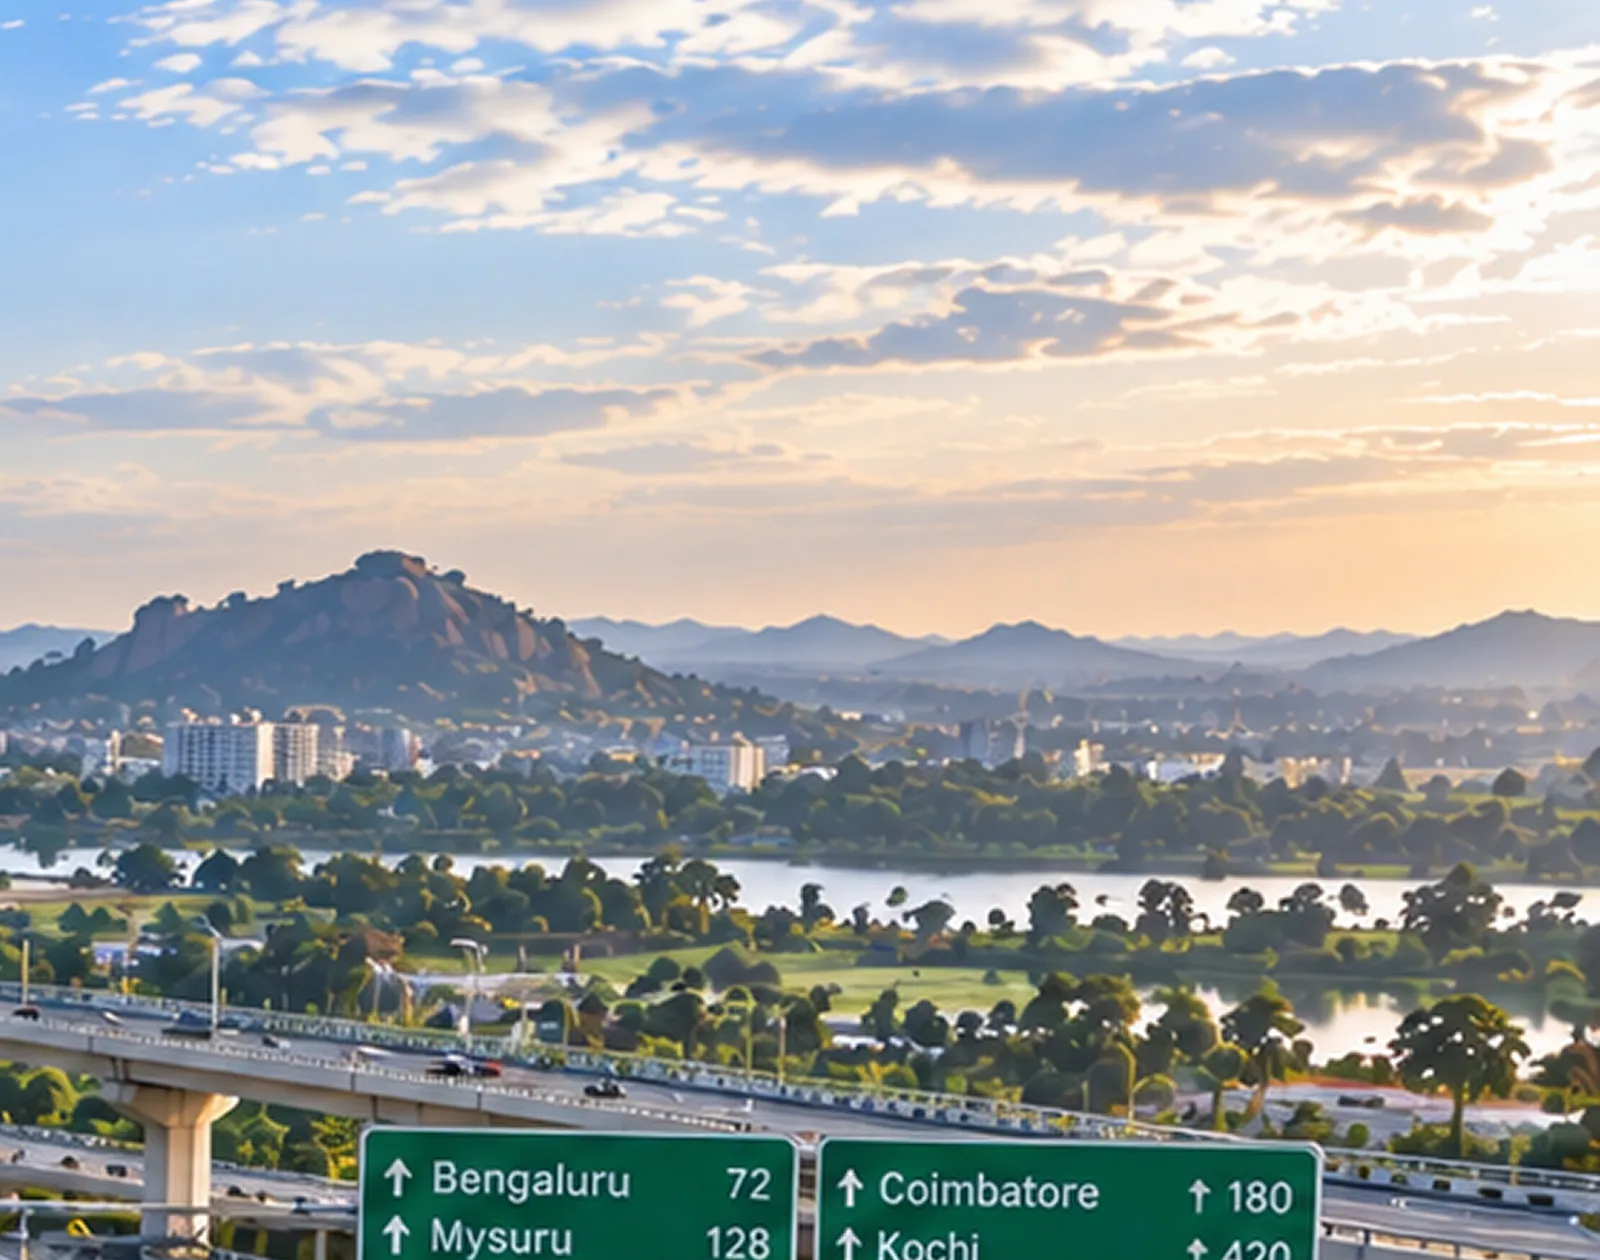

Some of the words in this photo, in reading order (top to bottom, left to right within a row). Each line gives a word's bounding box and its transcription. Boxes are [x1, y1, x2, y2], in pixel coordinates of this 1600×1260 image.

[432, 1160, 631, 1204] Bengaluru
[726, 1167, 771, 1201] 72
[879, 1171, 1100, 1210] Coimbatore
[1228, 1180, 1293, 1214] 180
[430, 1218, 572, 1260] Mysuru
[707, 1227, 770, 1260] 128
